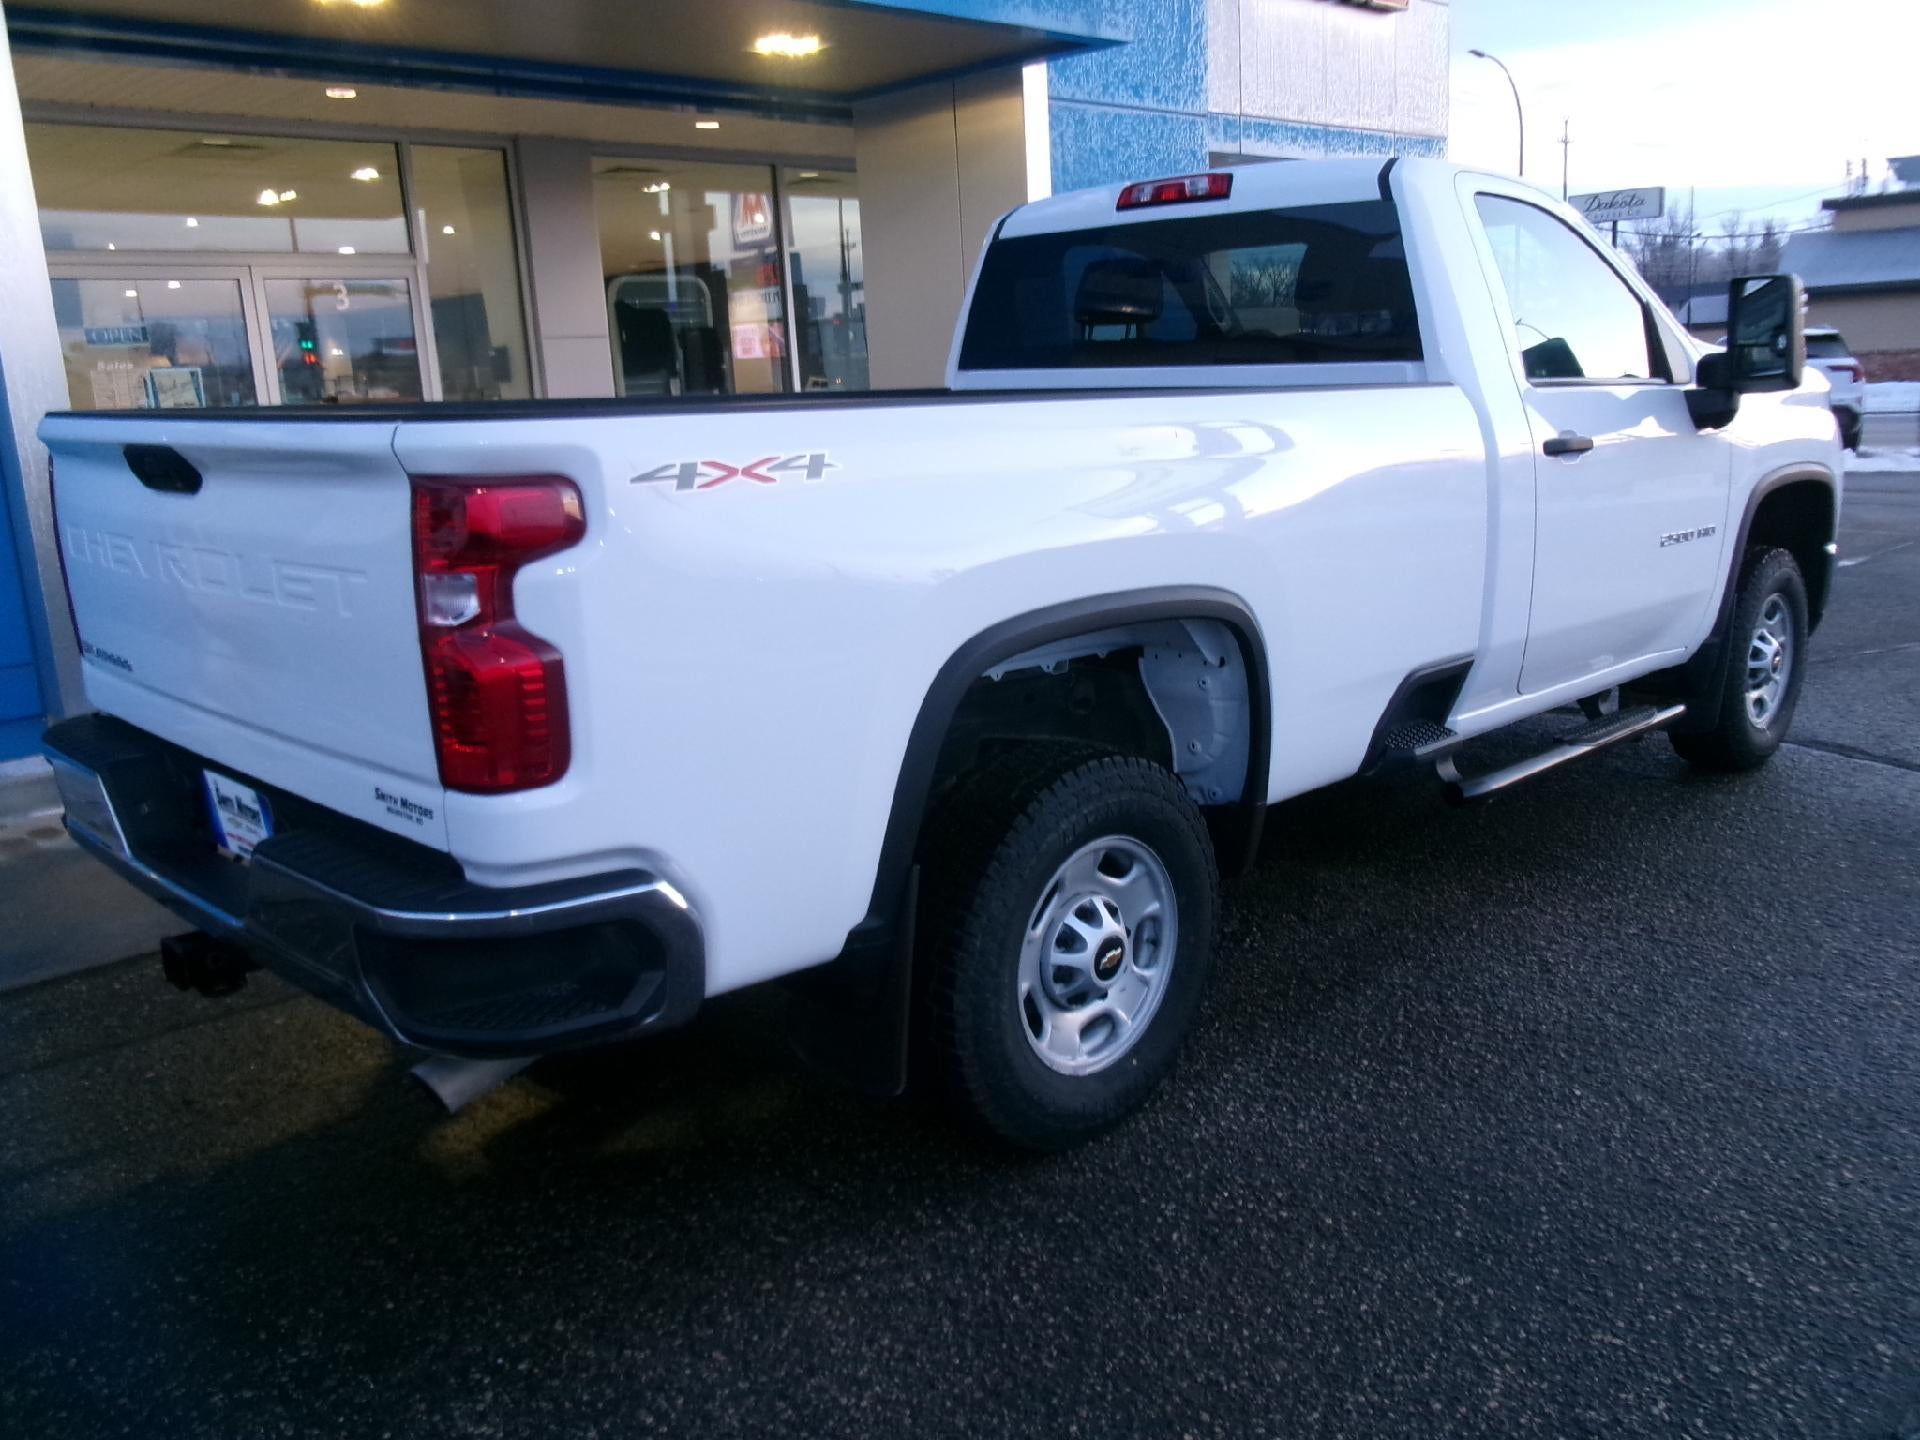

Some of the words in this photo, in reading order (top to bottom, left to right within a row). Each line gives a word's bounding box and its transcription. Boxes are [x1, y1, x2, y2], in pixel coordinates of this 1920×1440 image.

[1583, 191, 1647, 213] Dakota
[333, 284, 350, 310] 3
[1696, 525, 1717, 539] HD
[65, 525, 369, 618] CHEVROLET
